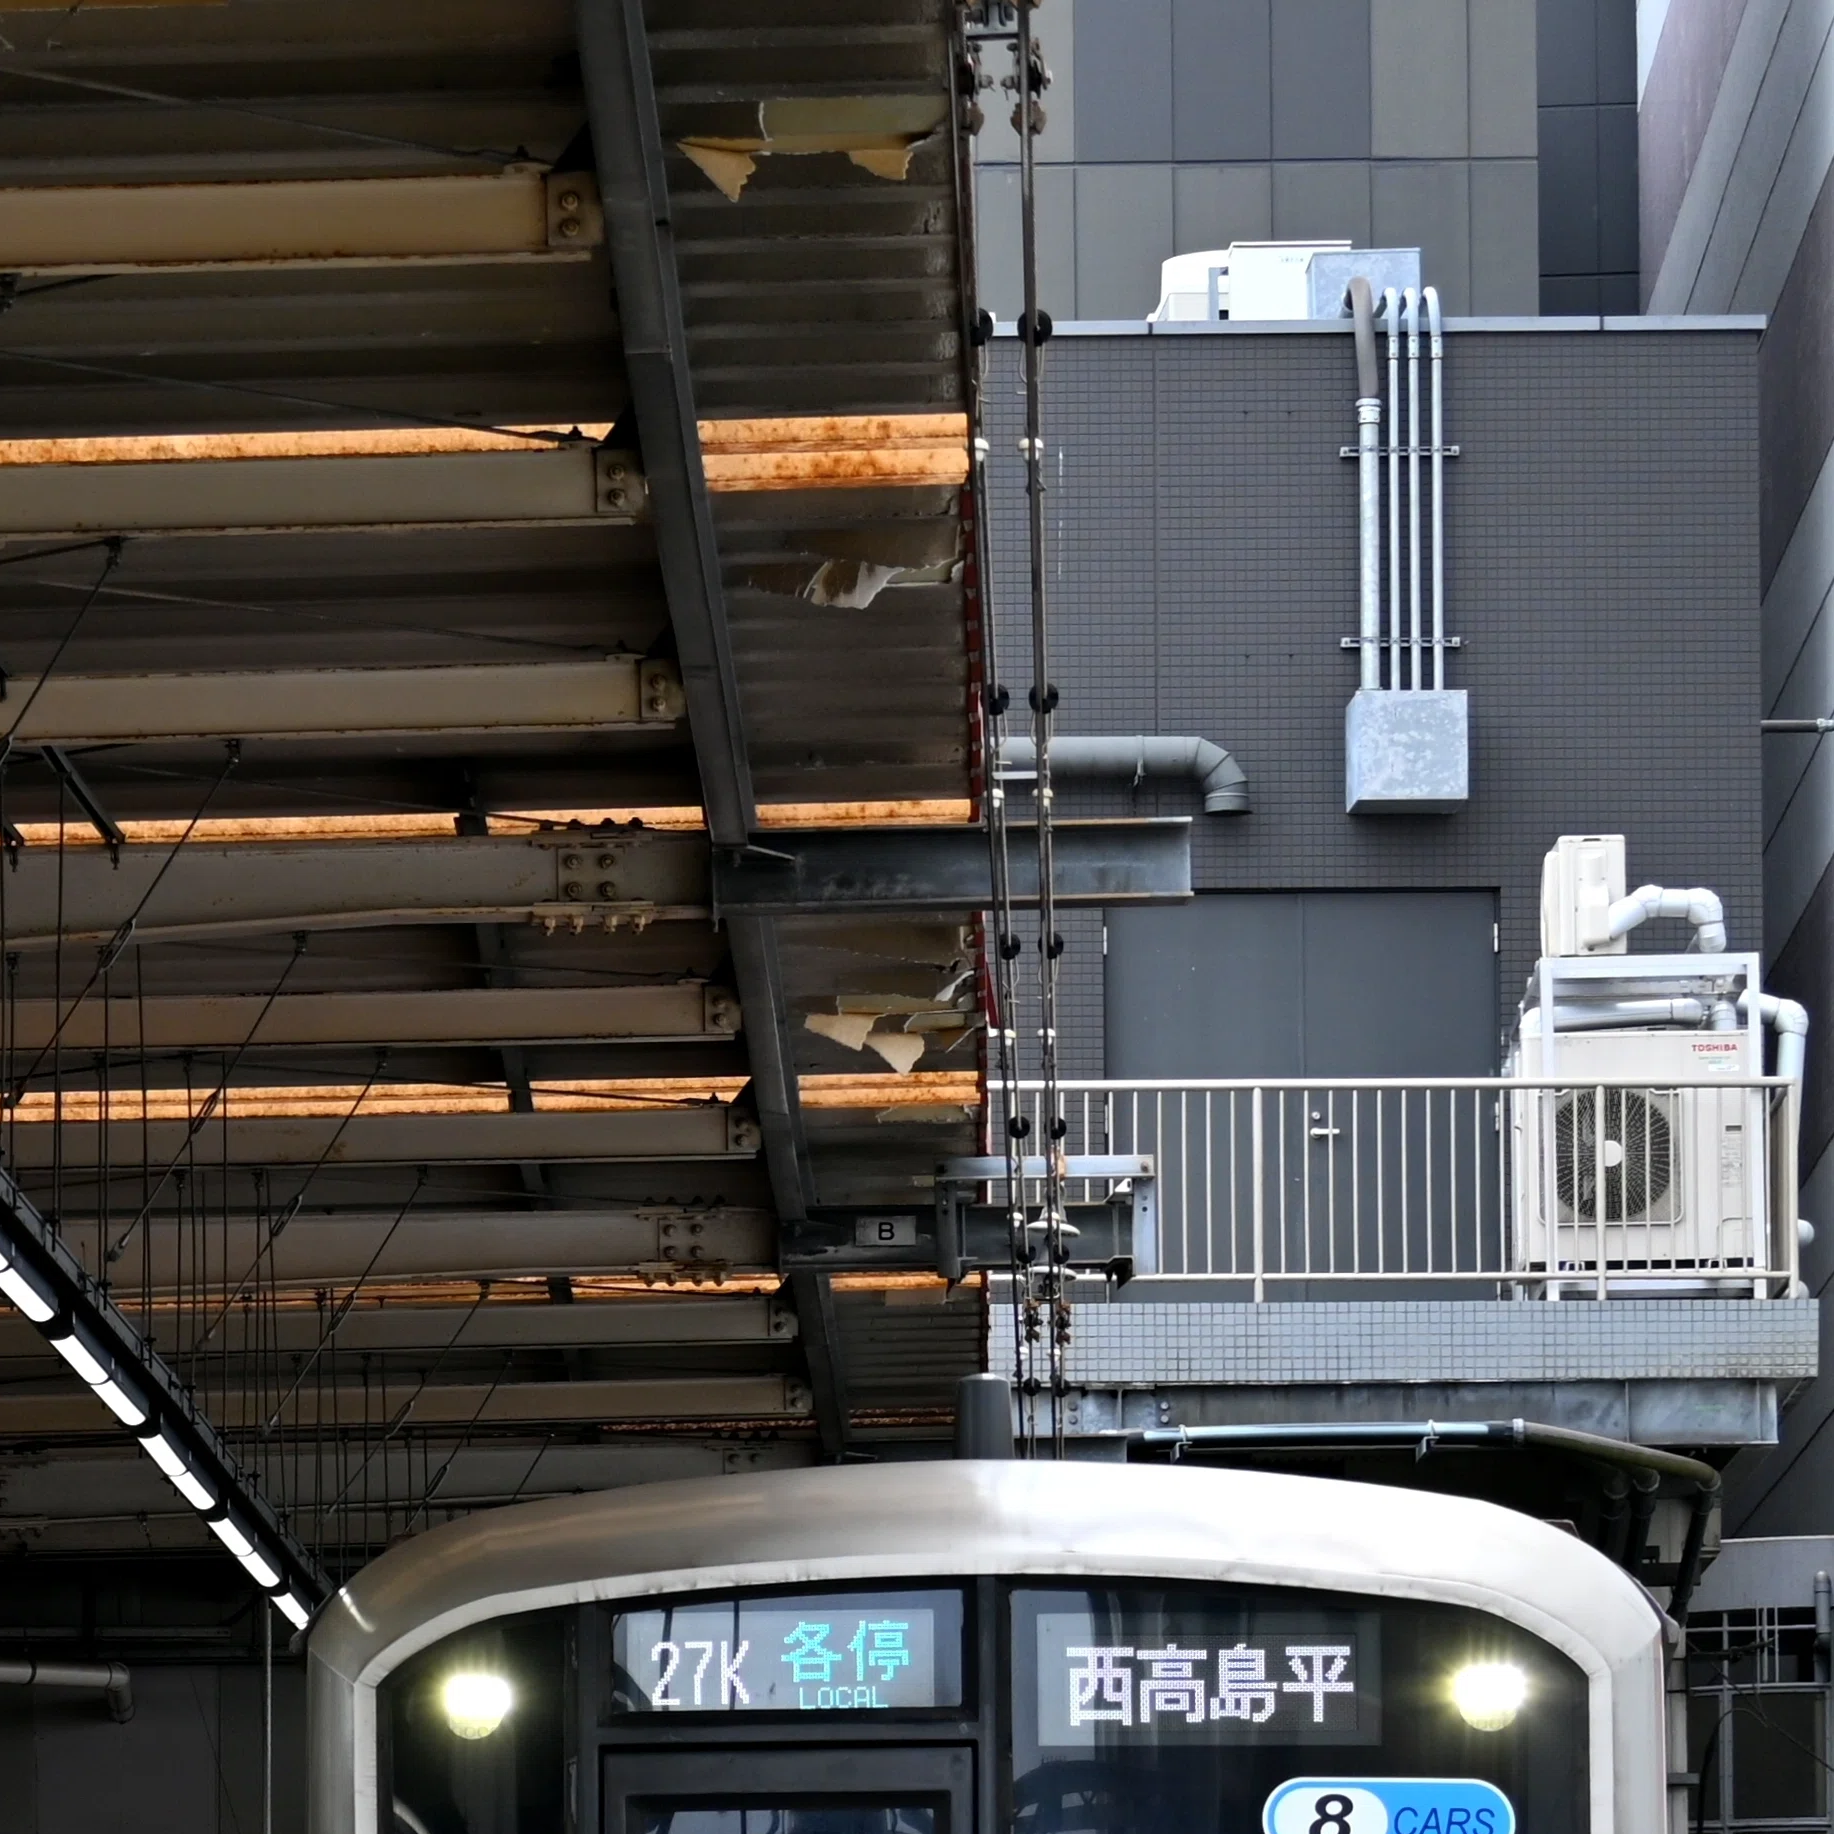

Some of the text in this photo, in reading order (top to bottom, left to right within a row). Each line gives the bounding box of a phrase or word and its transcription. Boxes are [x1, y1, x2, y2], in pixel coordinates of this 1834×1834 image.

[1691, 1043, 1738, 1052] TOSHIBA
[878, 1221, 895, 1240] B
[651, 1640, 750, 1706] 27K
[781, 1620, 909, 1683] 各停
[799, 1686, 889, 1710] LOCAL
[1066, 1643, 1354, 1726] 西高島平
